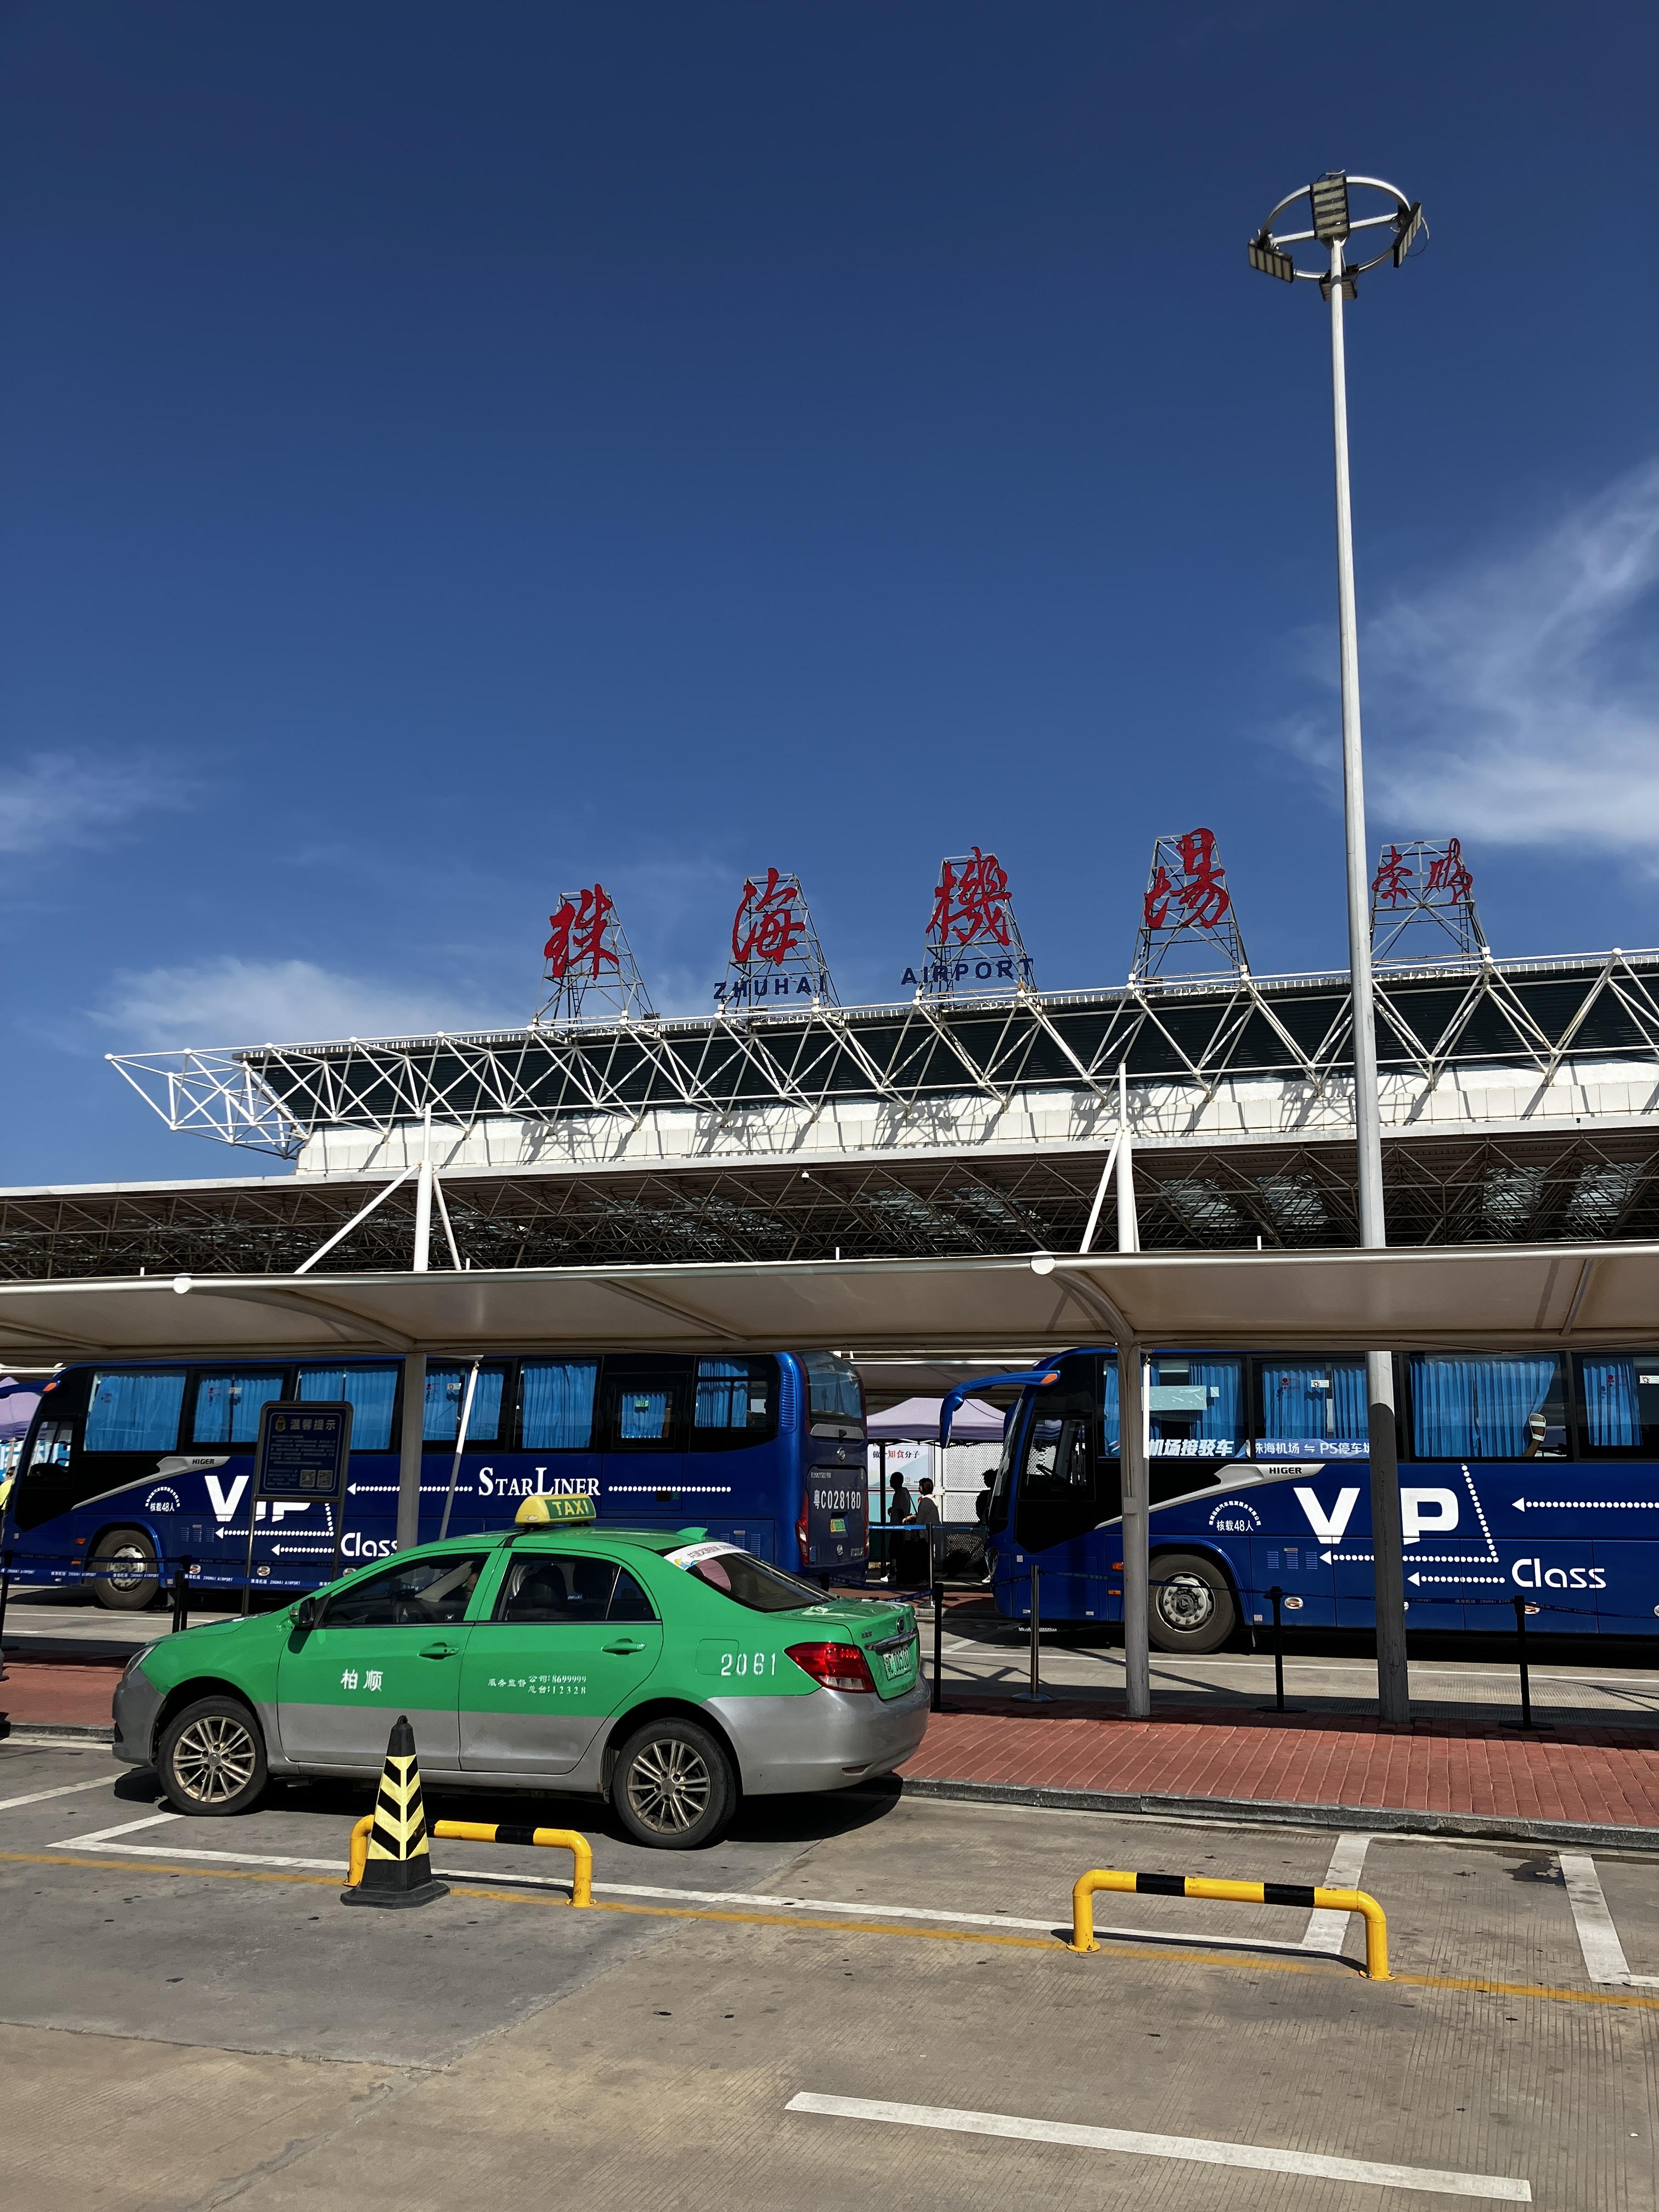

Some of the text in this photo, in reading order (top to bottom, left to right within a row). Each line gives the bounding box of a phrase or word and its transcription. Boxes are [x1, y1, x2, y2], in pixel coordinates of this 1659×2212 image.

[713, 958, 1034, 1000] ZHUHAI AIRPORT
[290, 1419, 336, 1430] 温馨提示
[873, 1449, 920, 1458] 做知食分子
[1149, 1438, 1235, 1457] 机场接驳车
[150, 1502, 175, 1512] 核载48人
[551, 1499, 590, 1516] TAXI
[813, 1489, 861, 1509] 粤C02818D
[1293, 1487, 1459, 1545] VP
[1216, 1520, 1254, 1532] 核载48人
[1511, 1558, 1607, 1589] Class
[721, 1653, 776, 1677] 2061
[340, 1668, 384, 1692] 柏顺
[488, 1678, 527, 1688] 服务监督
